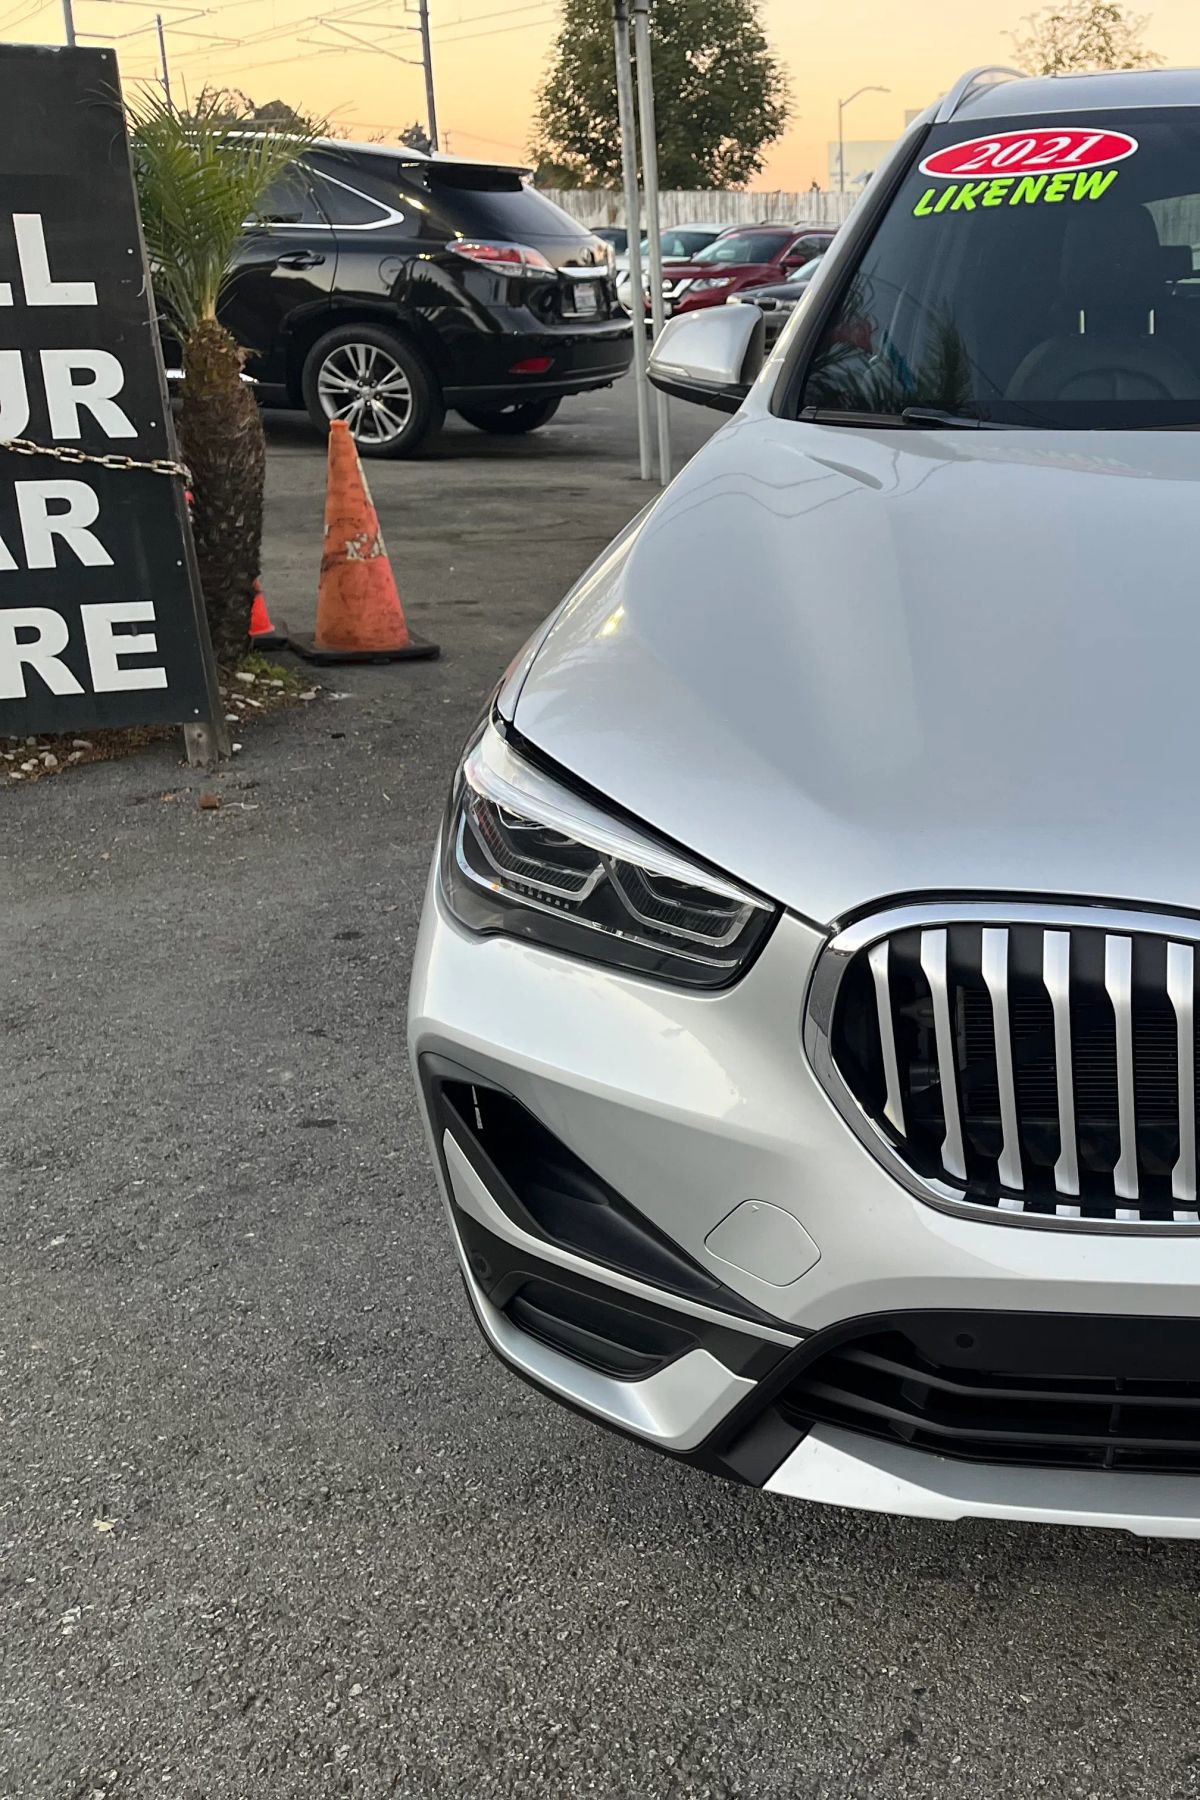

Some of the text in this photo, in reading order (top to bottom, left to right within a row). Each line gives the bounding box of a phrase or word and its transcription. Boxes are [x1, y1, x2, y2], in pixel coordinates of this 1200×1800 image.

[951, 134, 1104, 172] 2021
[0, 213, 98, 306] L
[0, 479, 115, 570] R
